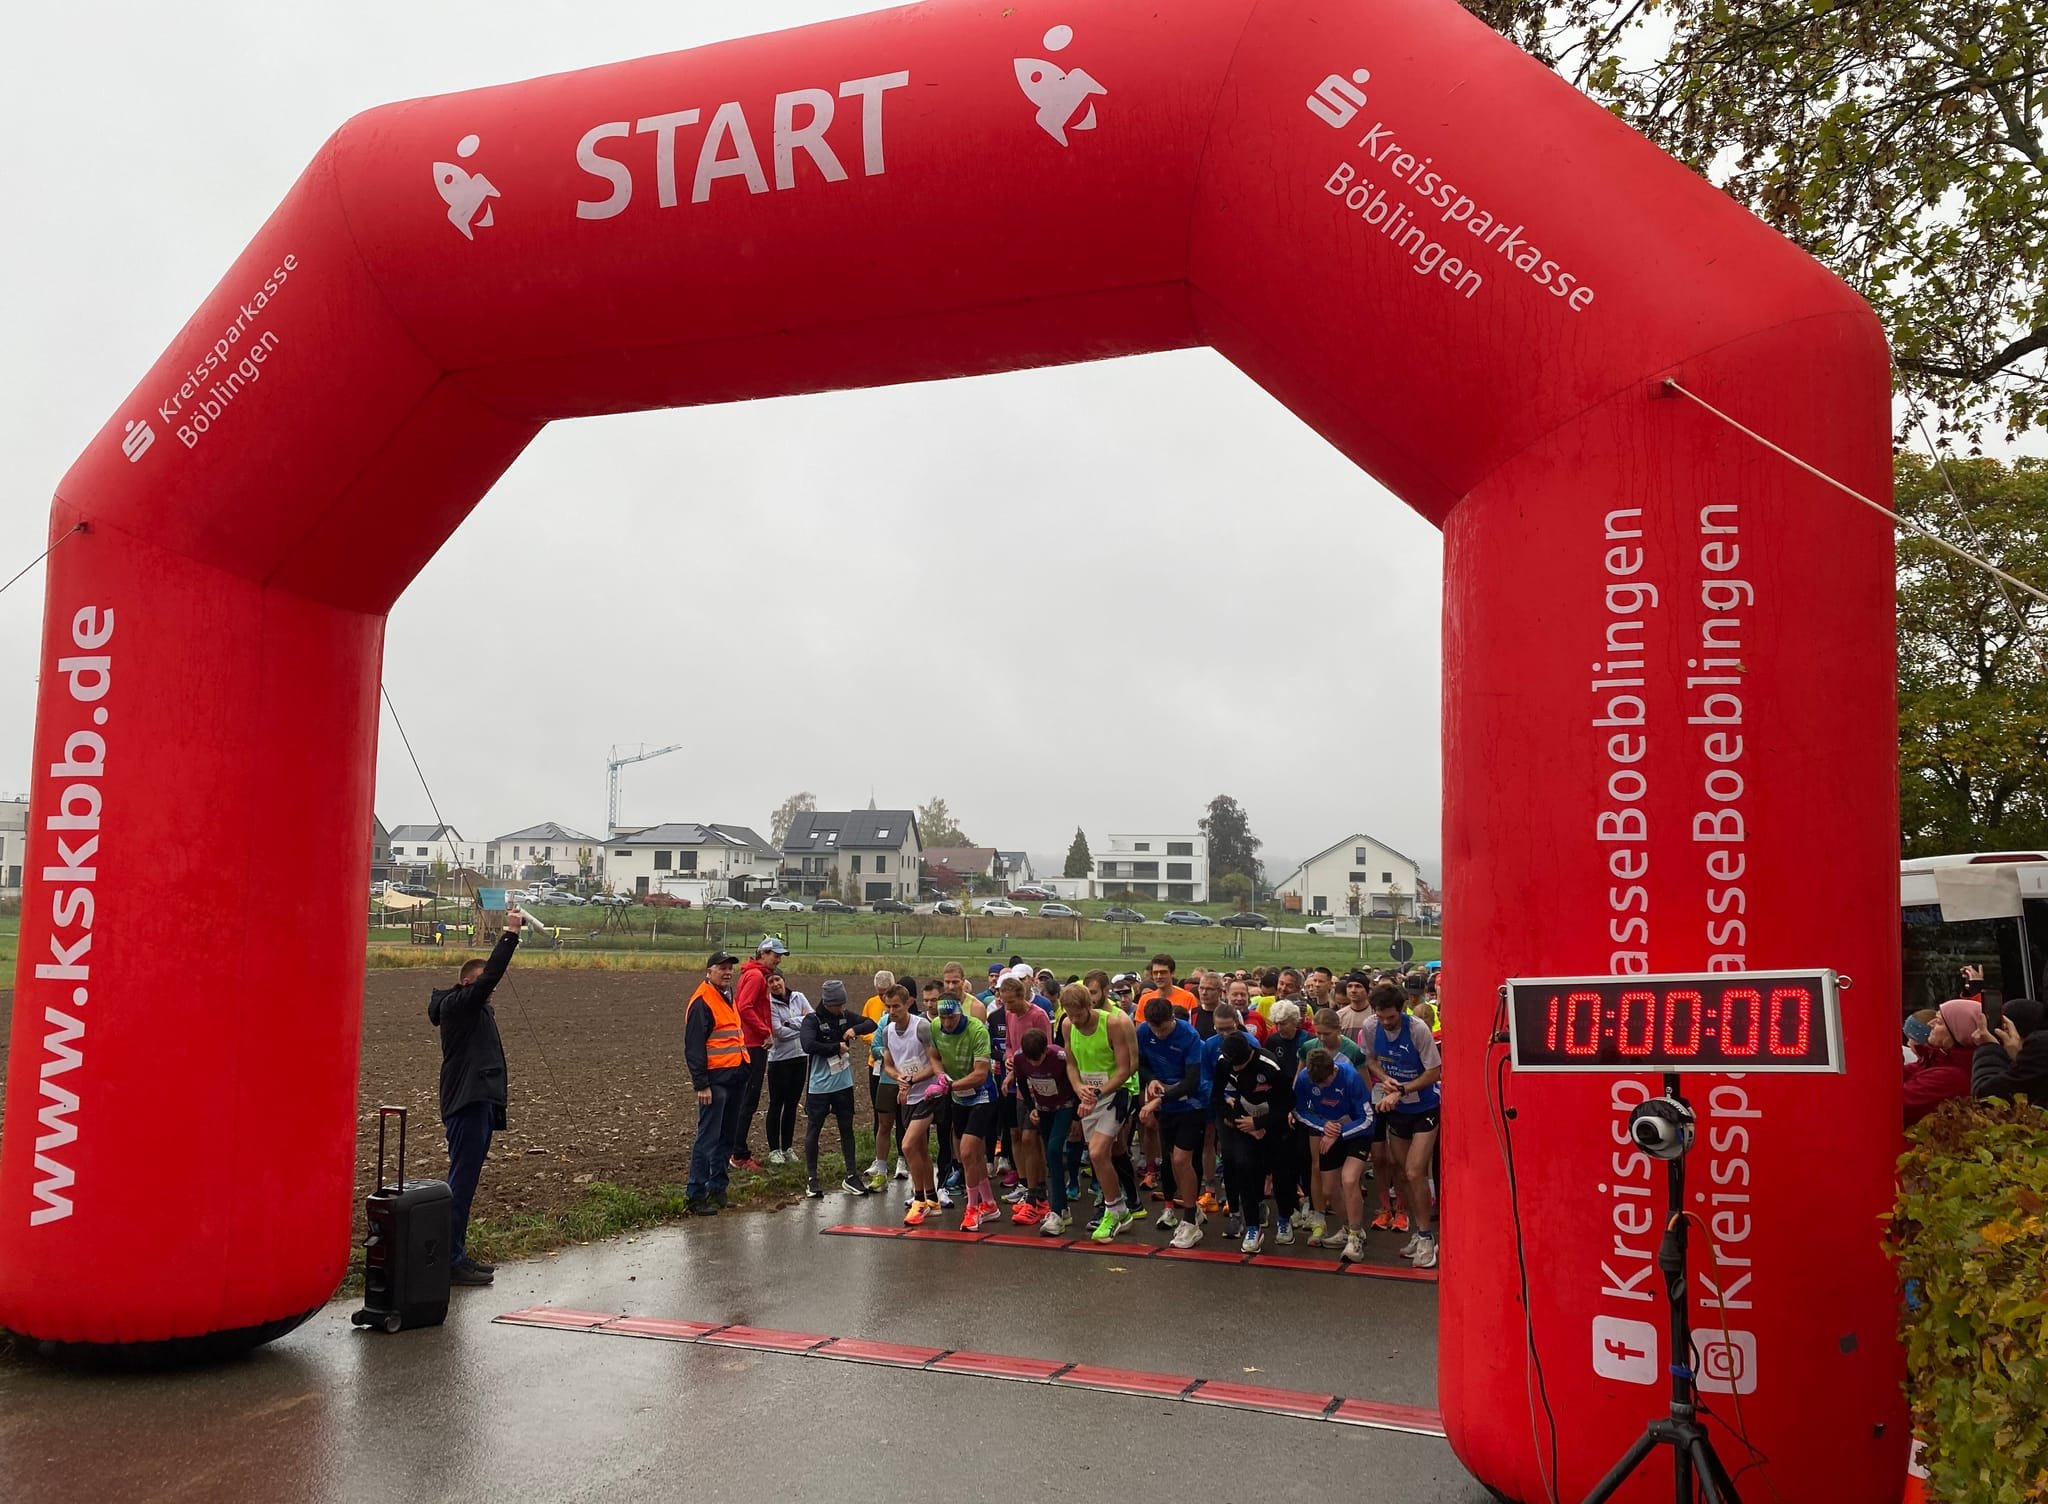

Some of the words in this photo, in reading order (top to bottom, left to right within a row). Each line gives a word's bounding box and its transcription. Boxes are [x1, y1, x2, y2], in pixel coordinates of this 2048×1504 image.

[575, 70, 909, 221] START
[1323, 161, 1483, 298] Böblingen
[1357, 121, 1595, 312] Kreissparkasse
[158, 253, 298, 423] Kreissparkasse
[176, 329, 279, 449] Böblingen
[30, 605, 114, 1226] www.kskbb.de
[1592, 507, 1658, 1301] KreisspasseBoeblingen
[1687, 503, 1762, 1309] KreisspasseBoeblingen
[1546, 987, 1812, 1056] 10:00:00
